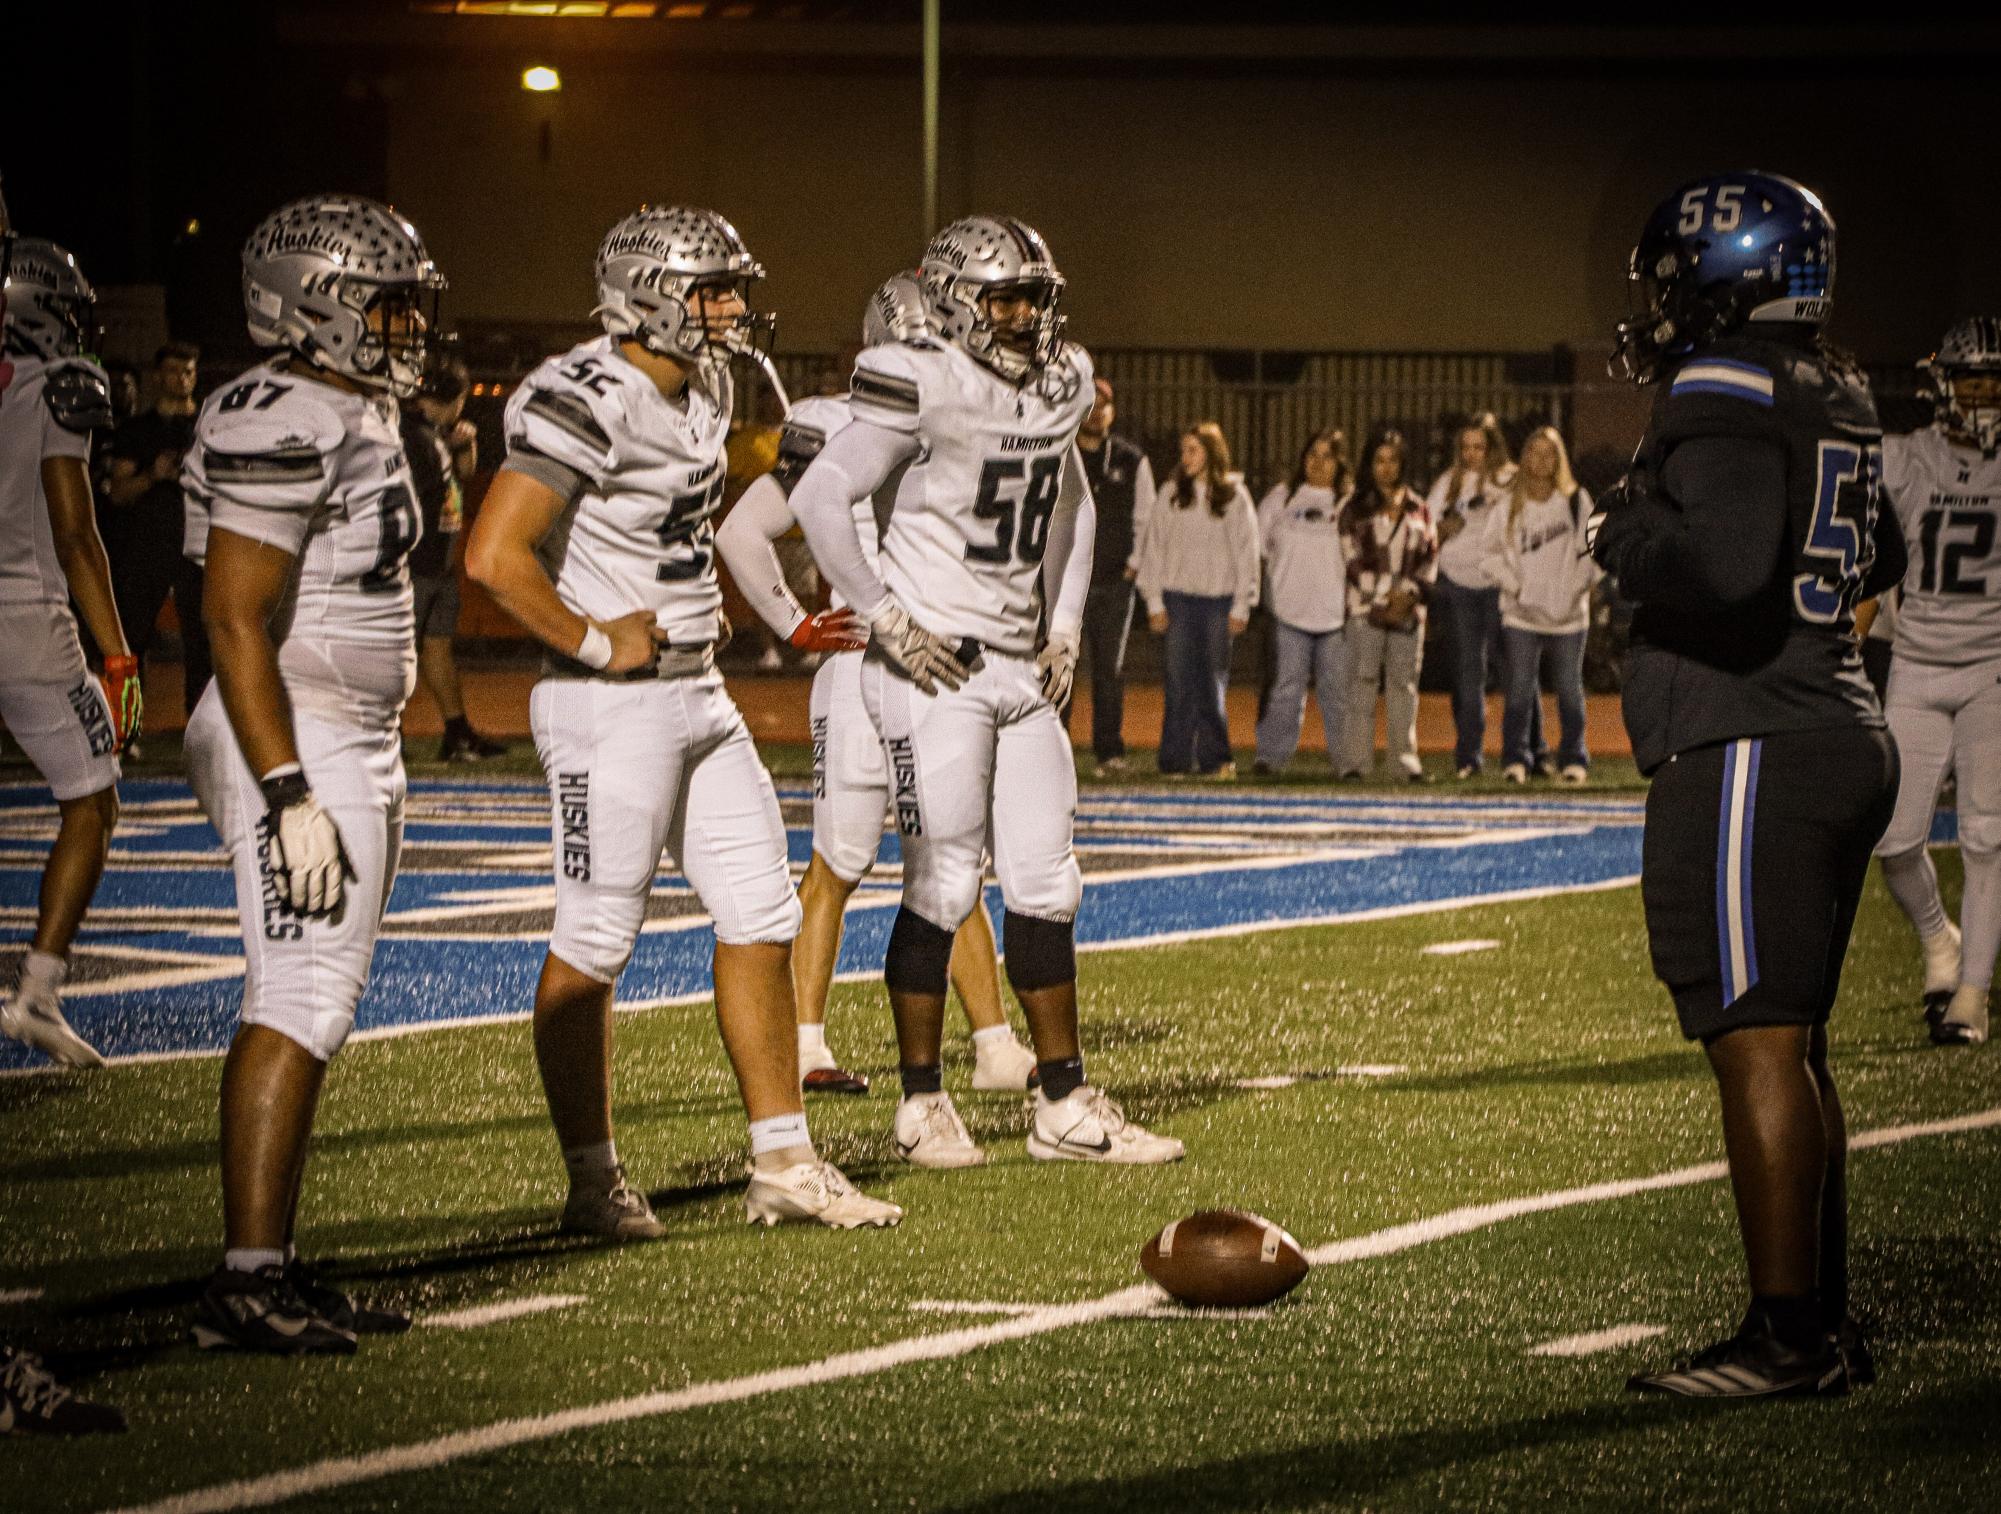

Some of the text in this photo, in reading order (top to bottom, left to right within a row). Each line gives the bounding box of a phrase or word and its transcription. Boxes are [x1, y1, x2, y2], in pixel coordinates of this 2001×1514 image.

[1678, 185, 1746, 235] 55
[1001, 436, 1053, 452] HAMILTON
[964, 455, 1062, 564] 58
[1918, 510, 1997, 596] 12
[559, 770, 591, 883] HUSKIES
[888, 735, 923, 837] HUSKIES
